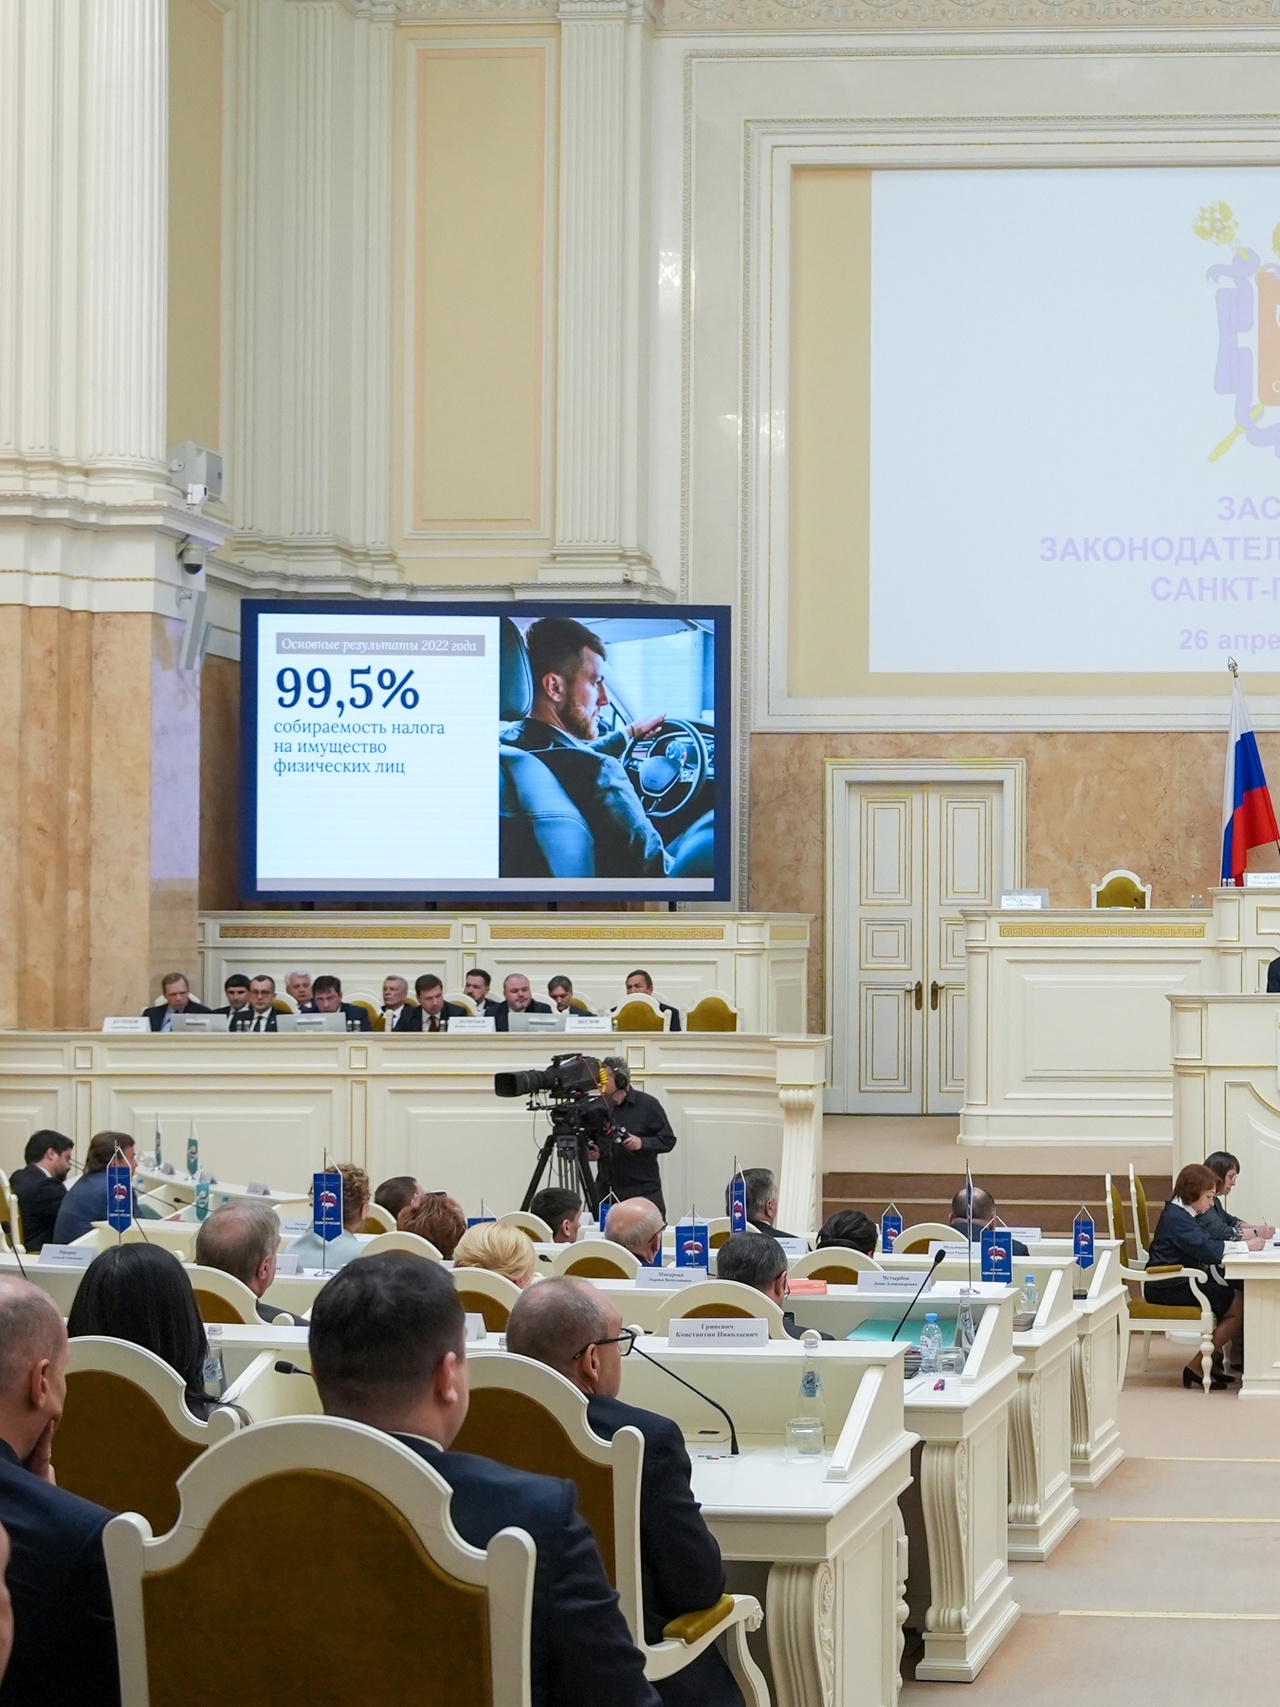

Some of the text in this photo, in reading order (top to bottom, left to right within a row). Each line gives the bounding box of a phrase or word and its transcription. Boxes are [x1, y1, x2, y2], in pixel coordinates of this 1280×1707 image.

[281, 637, 477, 654] Основные результаты 2022 года
[1178, 629, 1209, 650] 26
[276, 665, 420, 719] 99,5%
[274, 719, 445, 737] собираемость налога
[274, 741, 387, 758] на имущество
[274, 755, 406, 776] физических лиц
[701, 1323, 734, 1331] Гриневич
